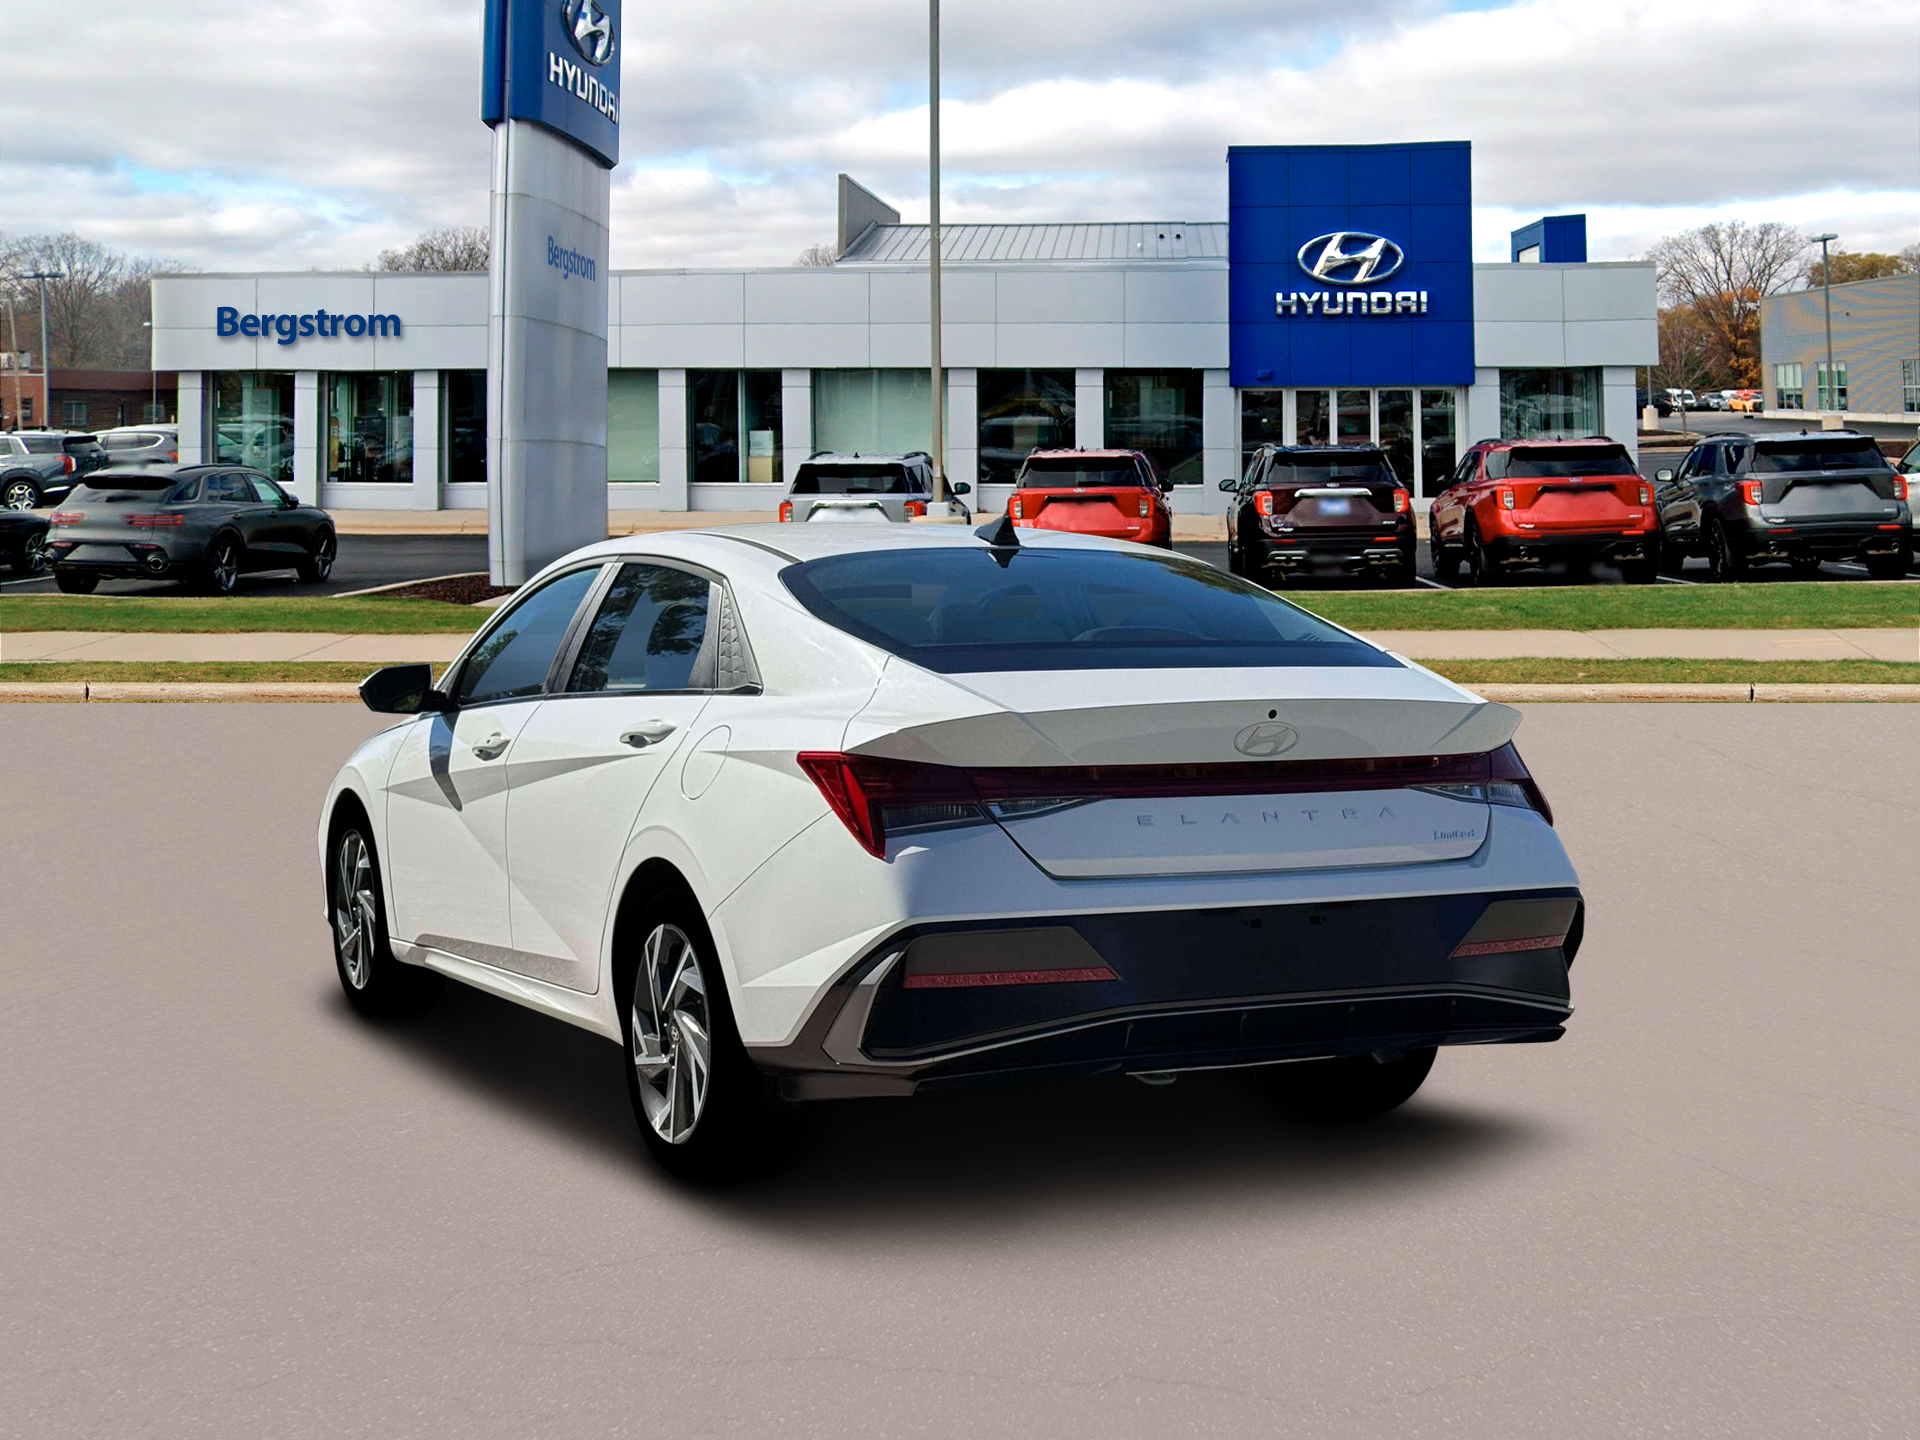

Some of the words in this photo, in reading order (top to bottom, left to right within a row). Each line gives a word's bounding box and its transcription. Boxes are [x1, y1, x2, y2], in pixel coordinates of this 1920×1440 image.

[549, 52, 619, 124] HYUNDAI
[548, 235, 595, 282] Bergstrom
[1275, 290, 1428, 315] HYUNDAI
[216, 306, 401, 346] Bergstrom
[1136, 806, 1396, 827] ELANTRA
